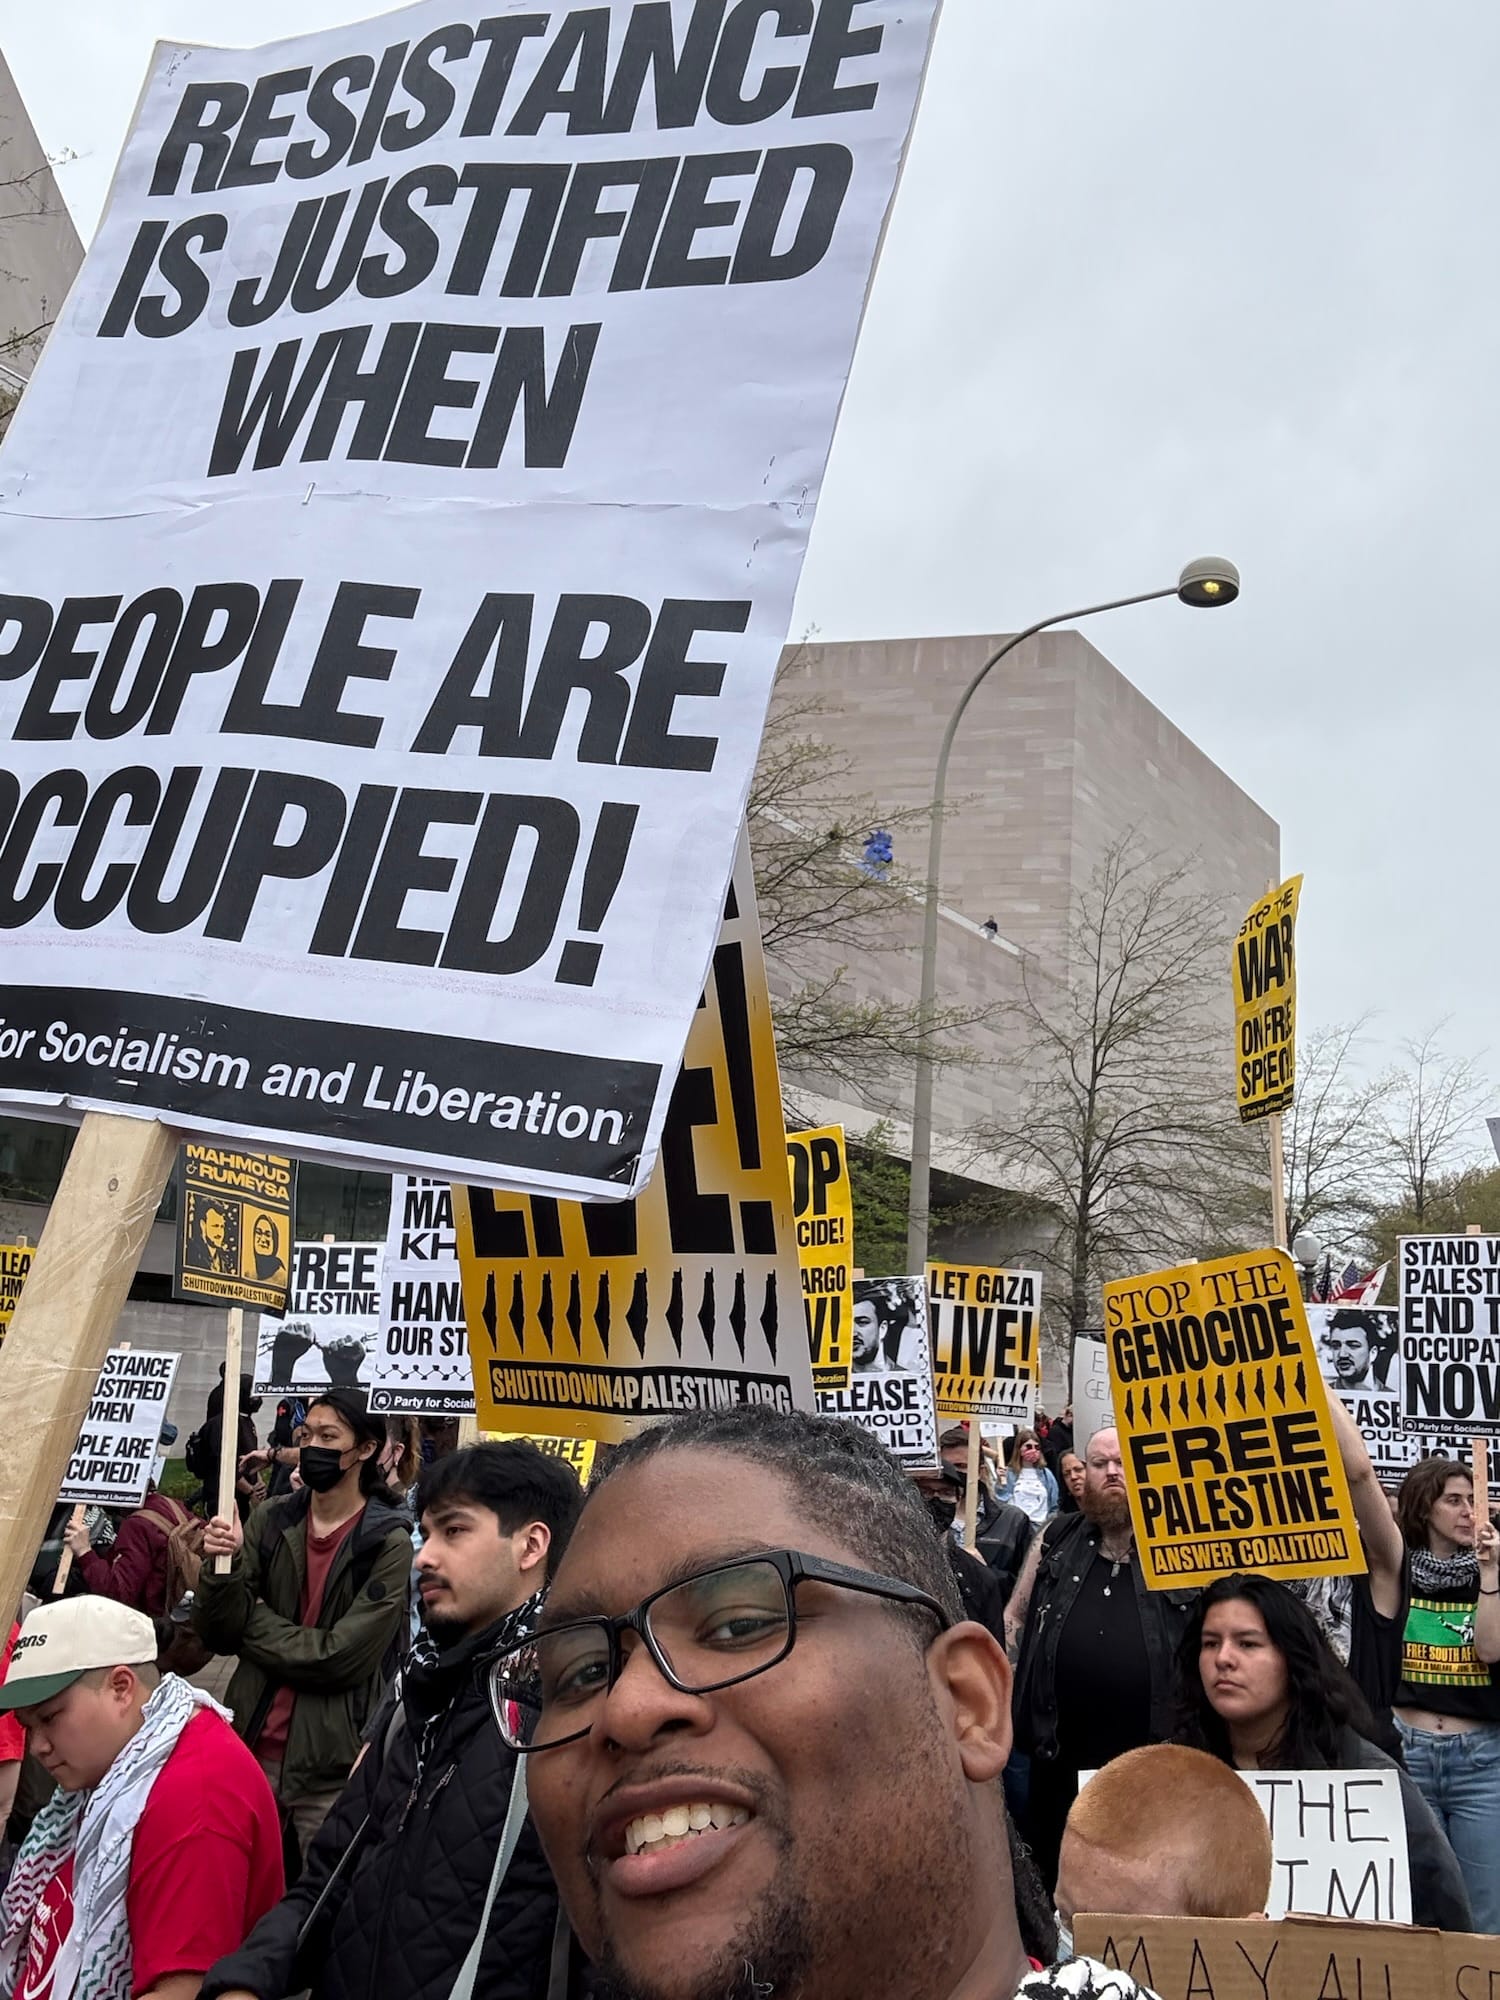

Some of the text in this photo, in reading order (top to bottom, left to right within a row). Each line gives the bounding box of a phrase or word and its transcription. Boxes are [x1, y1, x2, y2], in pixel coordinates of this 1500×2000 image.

[148, 0, 886, 197] RESISTANCE
[97, 143, 854, 338] IS JUSTIFIED
[206, 321, 602, 477] WHEN
[410, 593, 752, 773] ARE
[0, 766, 640, 986] CCUPIED!
[1238, 913, 1293, 1003] WAR
[39, 1020, 251, 1090] Socialism
[261, 1062, 356, 1105] and
[362, 1065, 624, 1146] Liberation
[186, 1144, 291, 1184] MAHMOUD
[199, 1163, 290, 1201] RUMEYSA
[1404, 1241, 1479, 1266] STAND
[390, 1282, 467, 1321] HAN
[930, 1270, 1034, 1306] LET GAZA
[1107, 1261, 1287, 1327] STOP THE
[1404, 1297, 1474, 1334] END
[386, 1327, 433, 1356] OUR
[930, 1303, 1033, 1380] LIVE!
[1112, 1297, 1302, 1383] GENOCIDE
[394, 1395, 423, 1410] Party
[425, 1396, 442, 1408] for
[491, 1367, 791, 1416] SHUTITDOWN4PALESTINEORG
[74, 1434, 154, 1459] PLE ARE
[1129, 1410, 1327, 1484] FREE
[1418, 1422, 1440, 1433] Party
[1440, 1423, 1454, 1432] for
[1454, 1424, 1493, 1434] Socialism
[1137, 1466, 1341, 1538] PALESTINE
[1154, 1530, 1342, 1574] ANSWER COALITION
[1406, 1643, 1427, 1659] FREE
[1429, 1646, 1460, 1662] SOUTH
[1256, 1779, 1389, 1842] THE
[1103, 1935, 1279, 2000] MAY
